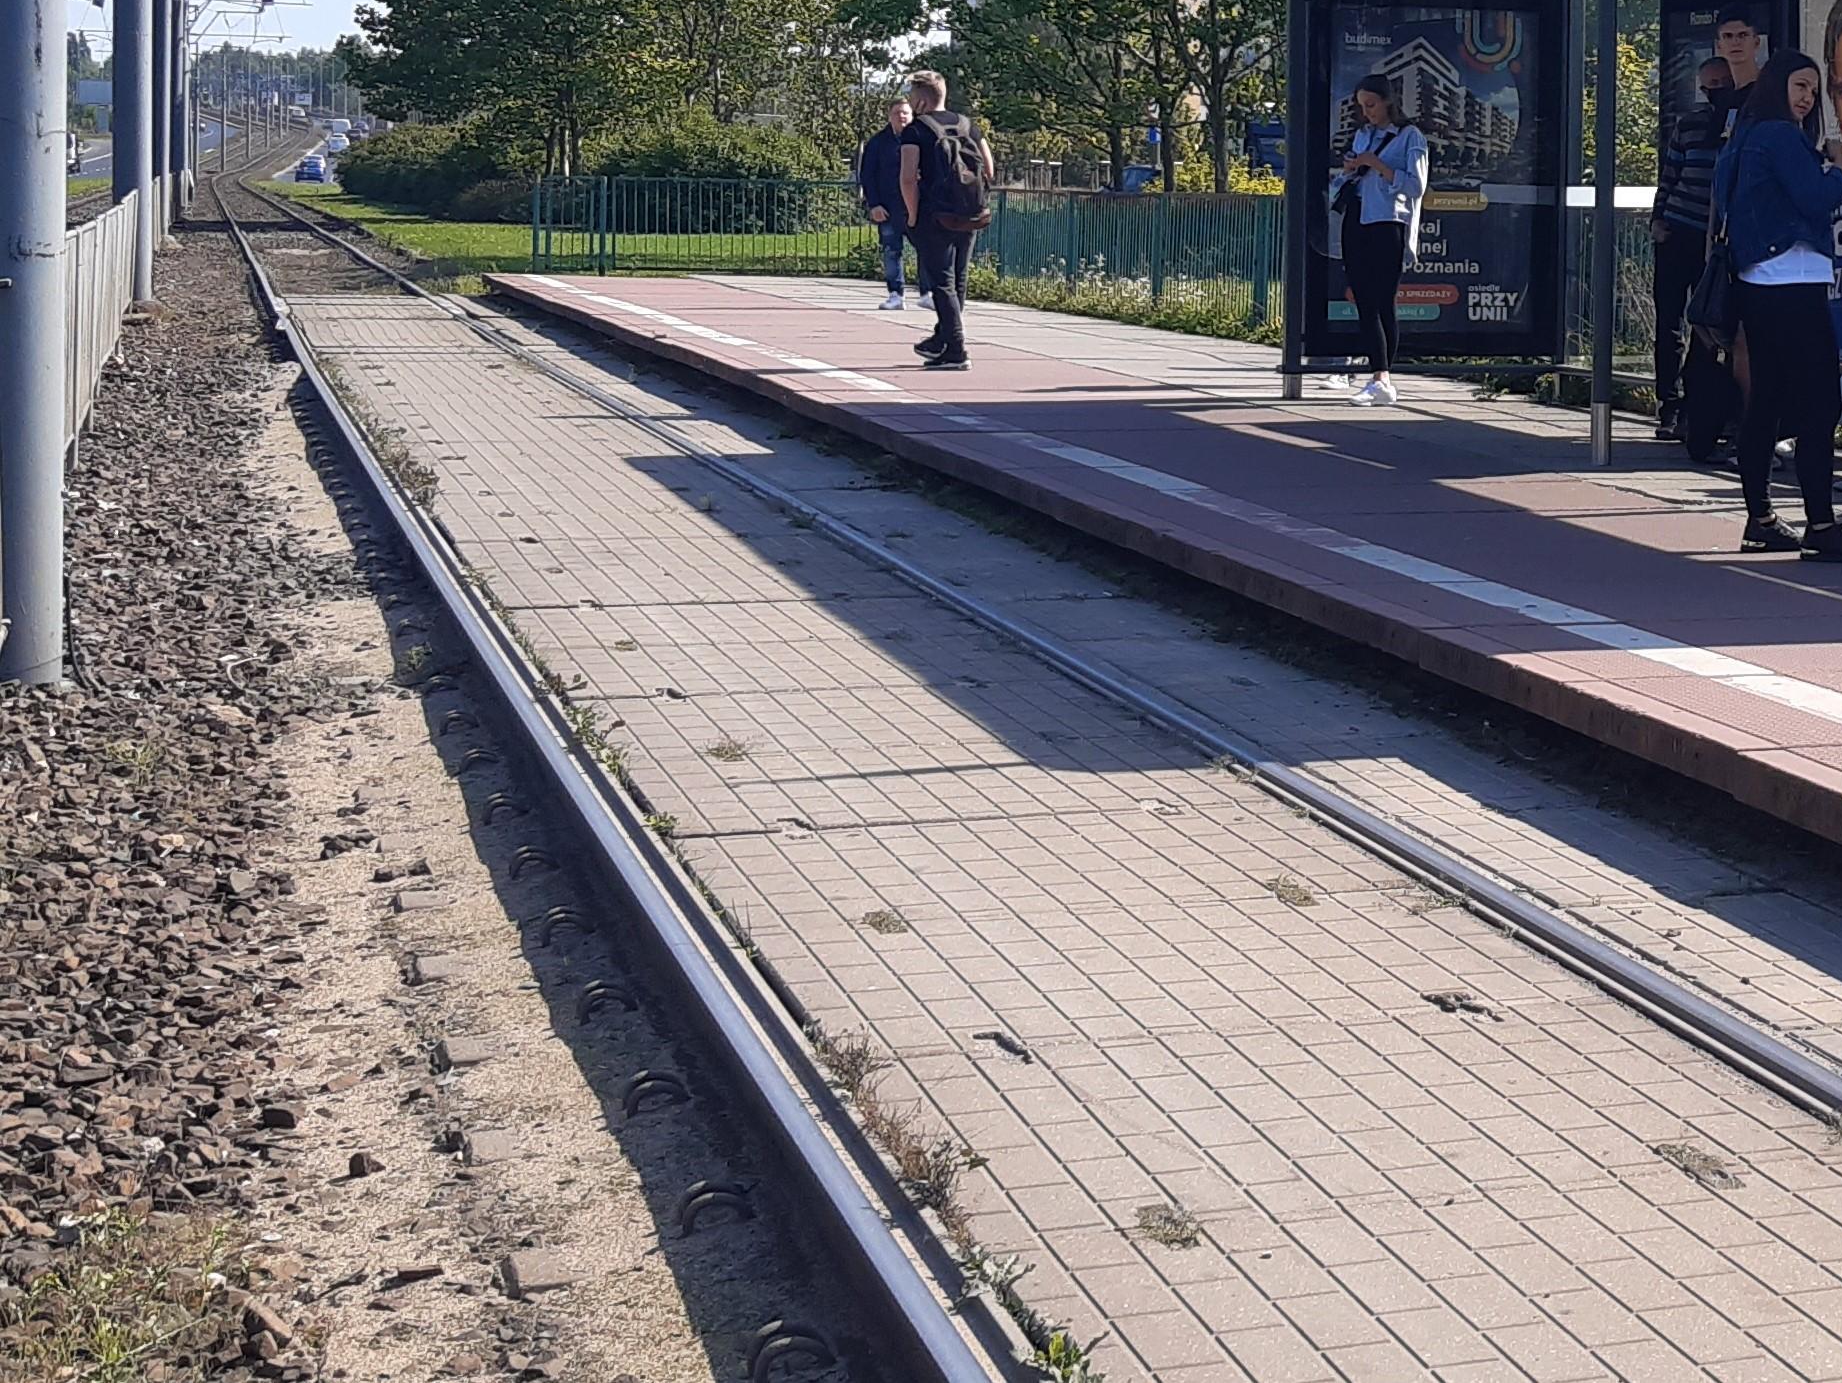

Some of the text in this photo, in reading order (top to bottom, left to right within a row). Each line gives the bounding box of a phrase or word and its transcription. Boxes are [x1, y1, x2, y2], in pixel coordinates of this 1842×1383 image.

[1345, 32, 1392, 45] budimex
[1402, 259, 1480, 274] Poznania
[1468, 293, 1519, 307] PRZY
[1468, 307, 1508, 321] UNII
